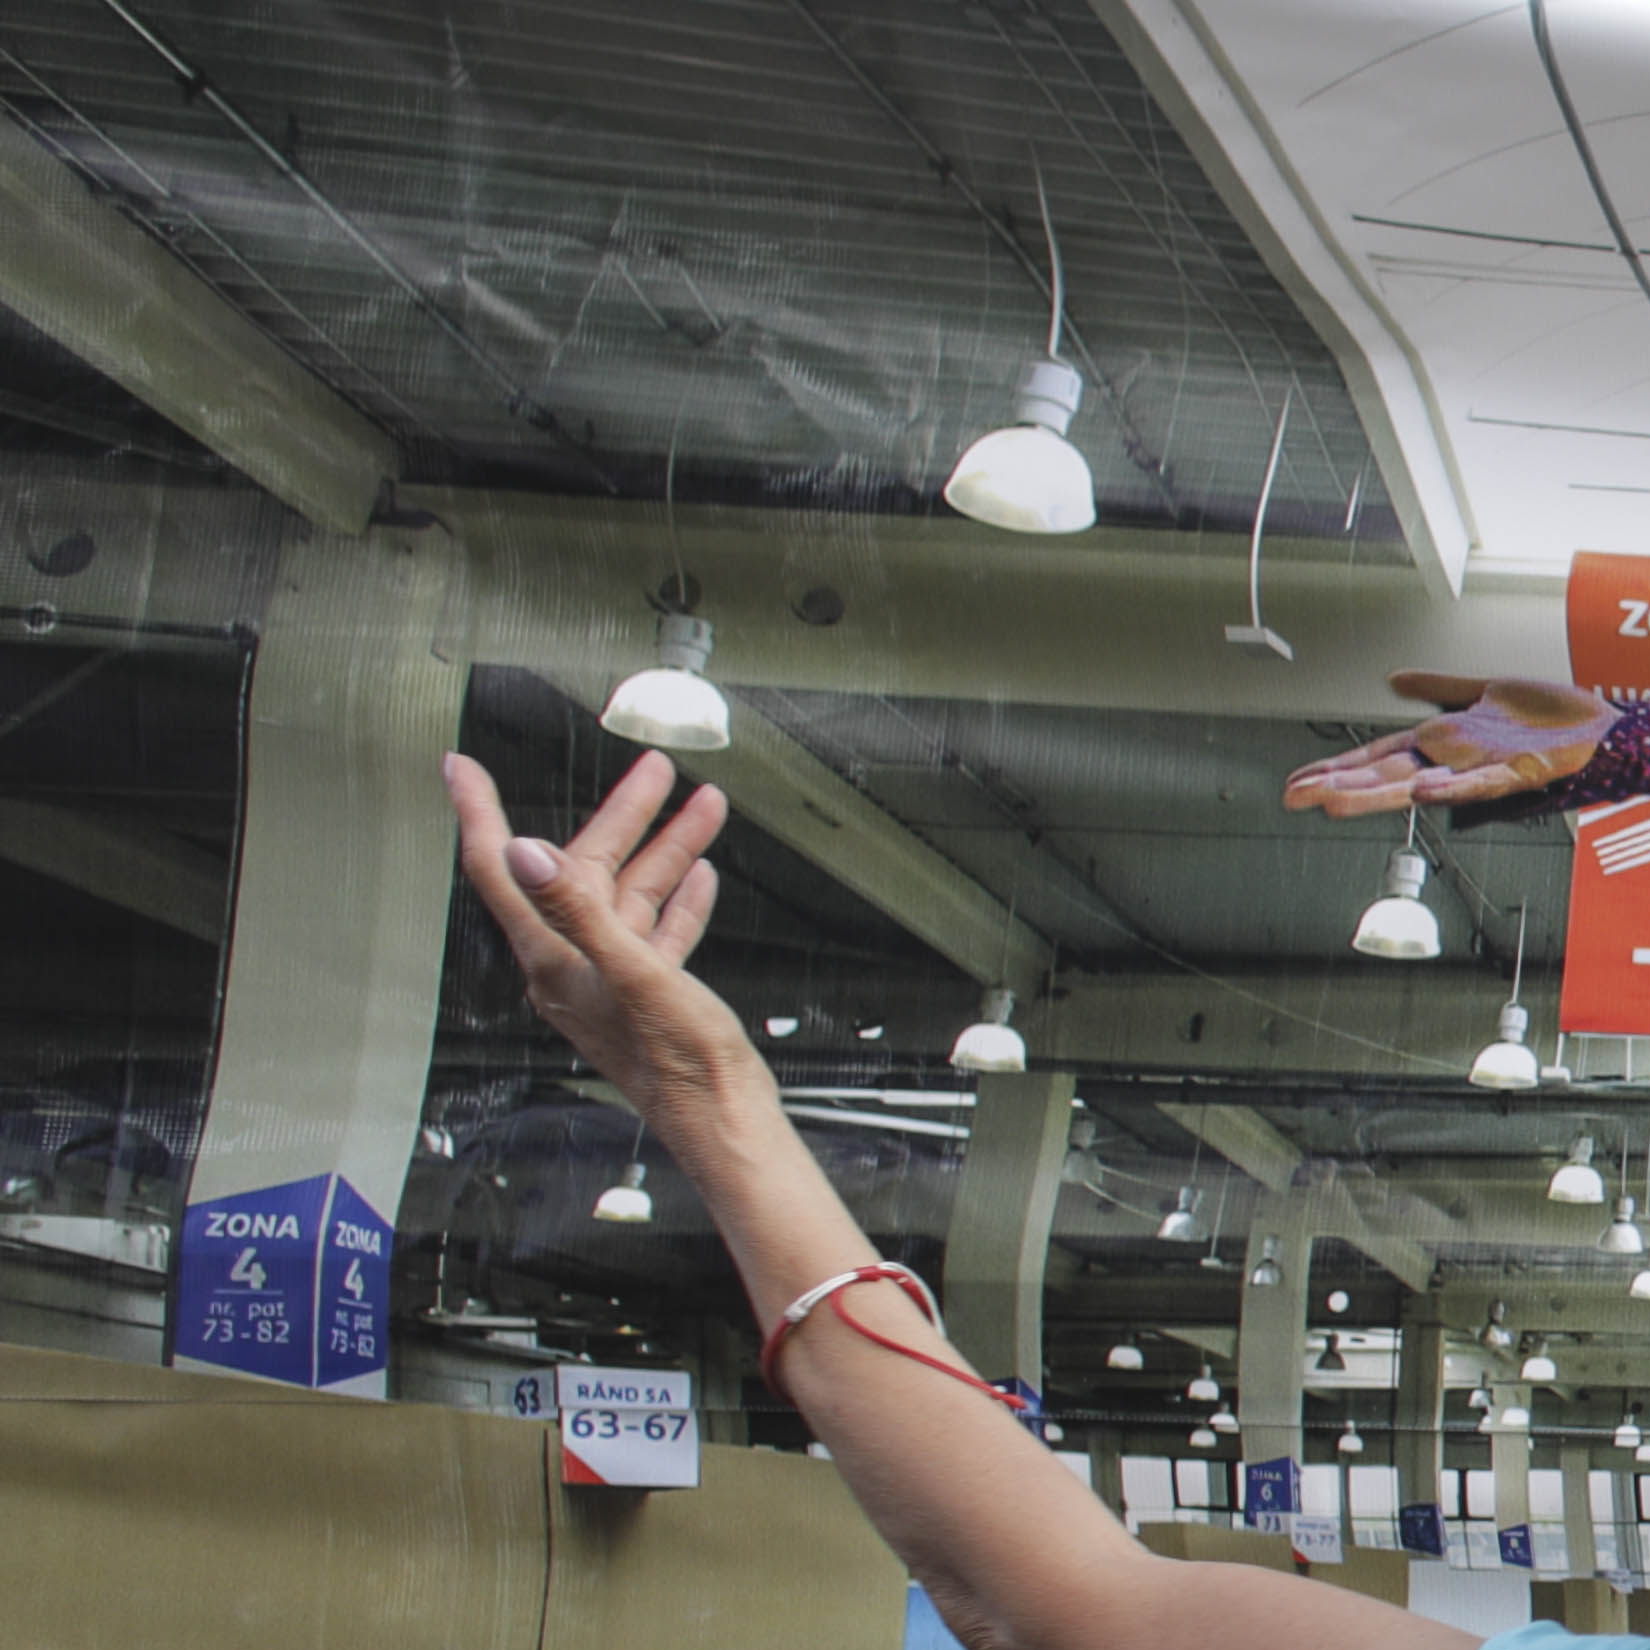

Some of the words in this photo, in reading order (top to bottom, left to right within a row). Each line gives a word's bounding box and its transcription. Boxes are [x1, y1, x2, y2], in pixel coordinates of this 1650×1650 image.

[204, 1211, 300, 1240] ZONA
[335, 1220, 382, 1257] ZONA
[230, 1247, 267, 1290] 4
[344, 1257, 365, 1301] 4
[248, 1301, 285, 1318] pot
[514, 1376, 541, 1416] 63
[1260, 1482, 1273, 1501] 6
